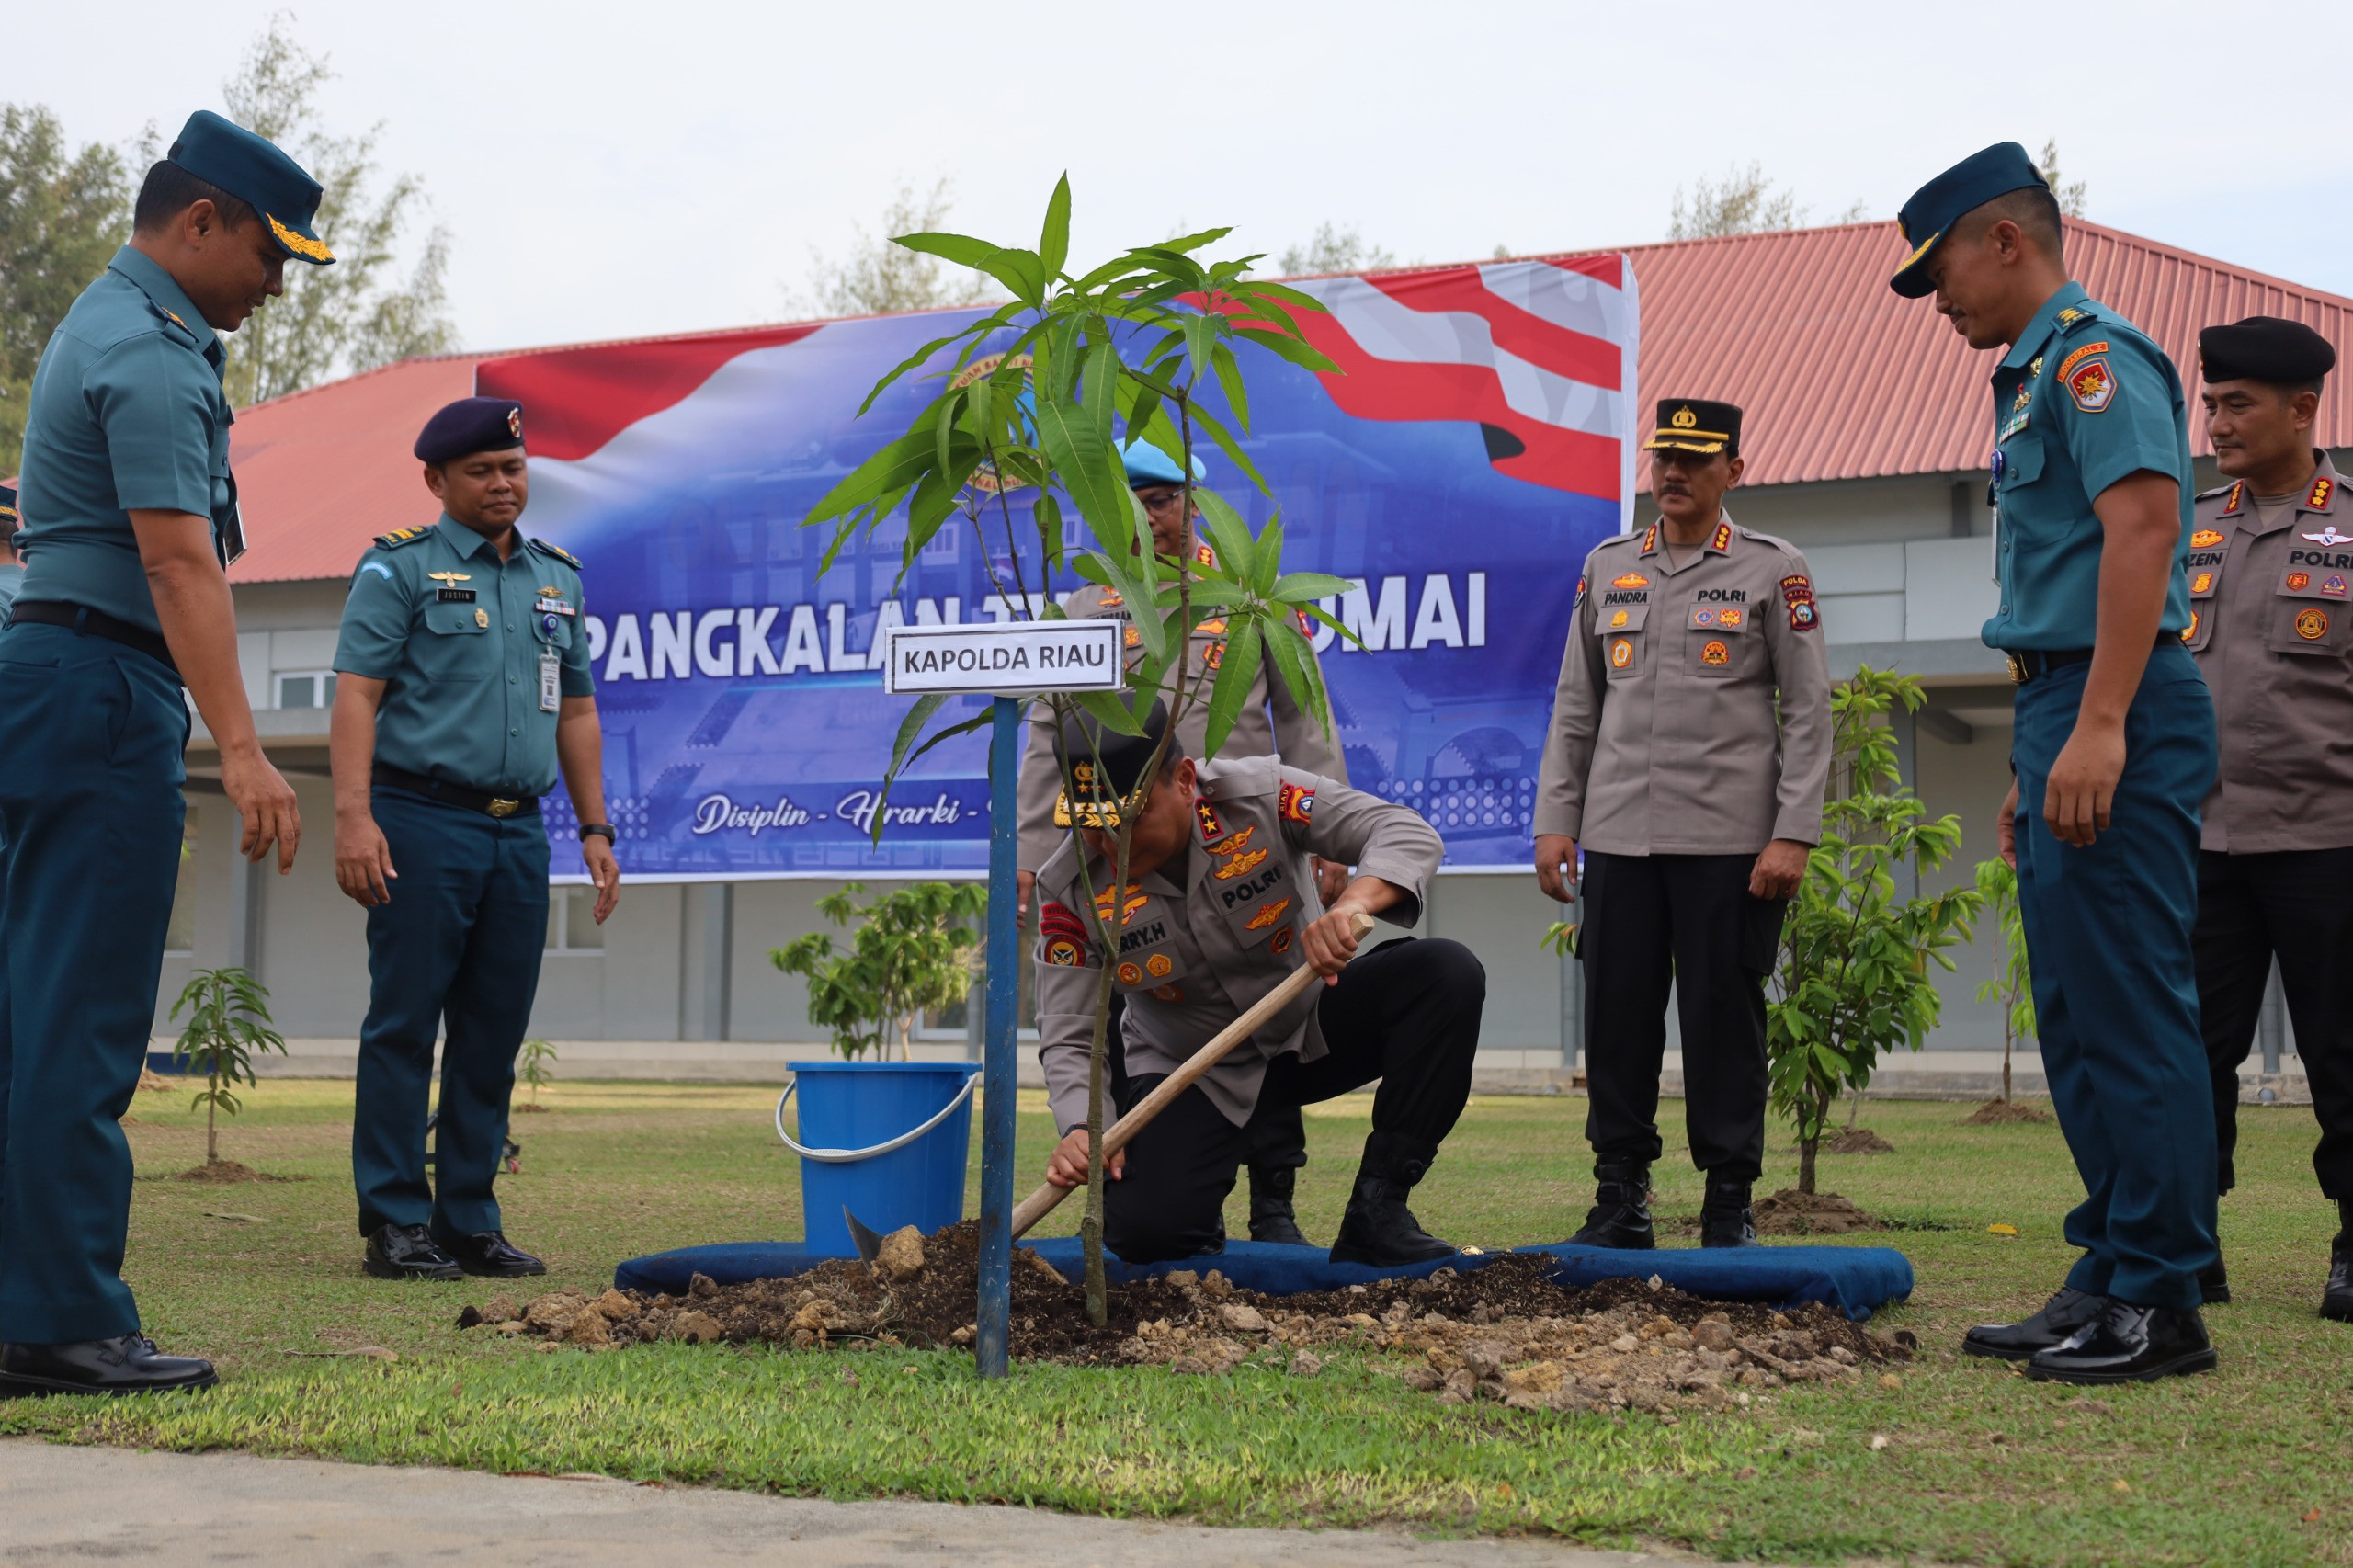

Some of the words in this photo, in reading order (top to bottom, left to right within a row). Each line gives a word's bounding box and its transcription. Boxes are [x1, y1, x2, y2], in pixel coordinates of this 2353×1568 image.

[1783, 577, 1808, 587] POLDA
[1604, 591, 1648, 606] PANDRA
[1697, 589, 1746, 603] POLRI
[905, 647, 1030, 674] KAPOLDA
[1040, 644, 1105, 669] RIAU
[1279, 790, 1289, 812] RIAU
[692, 794, 810, 836] Disiplin
[1222, 866, 1282, 909] POLRI
[1099, 921, 1166, 954] RRY.H
